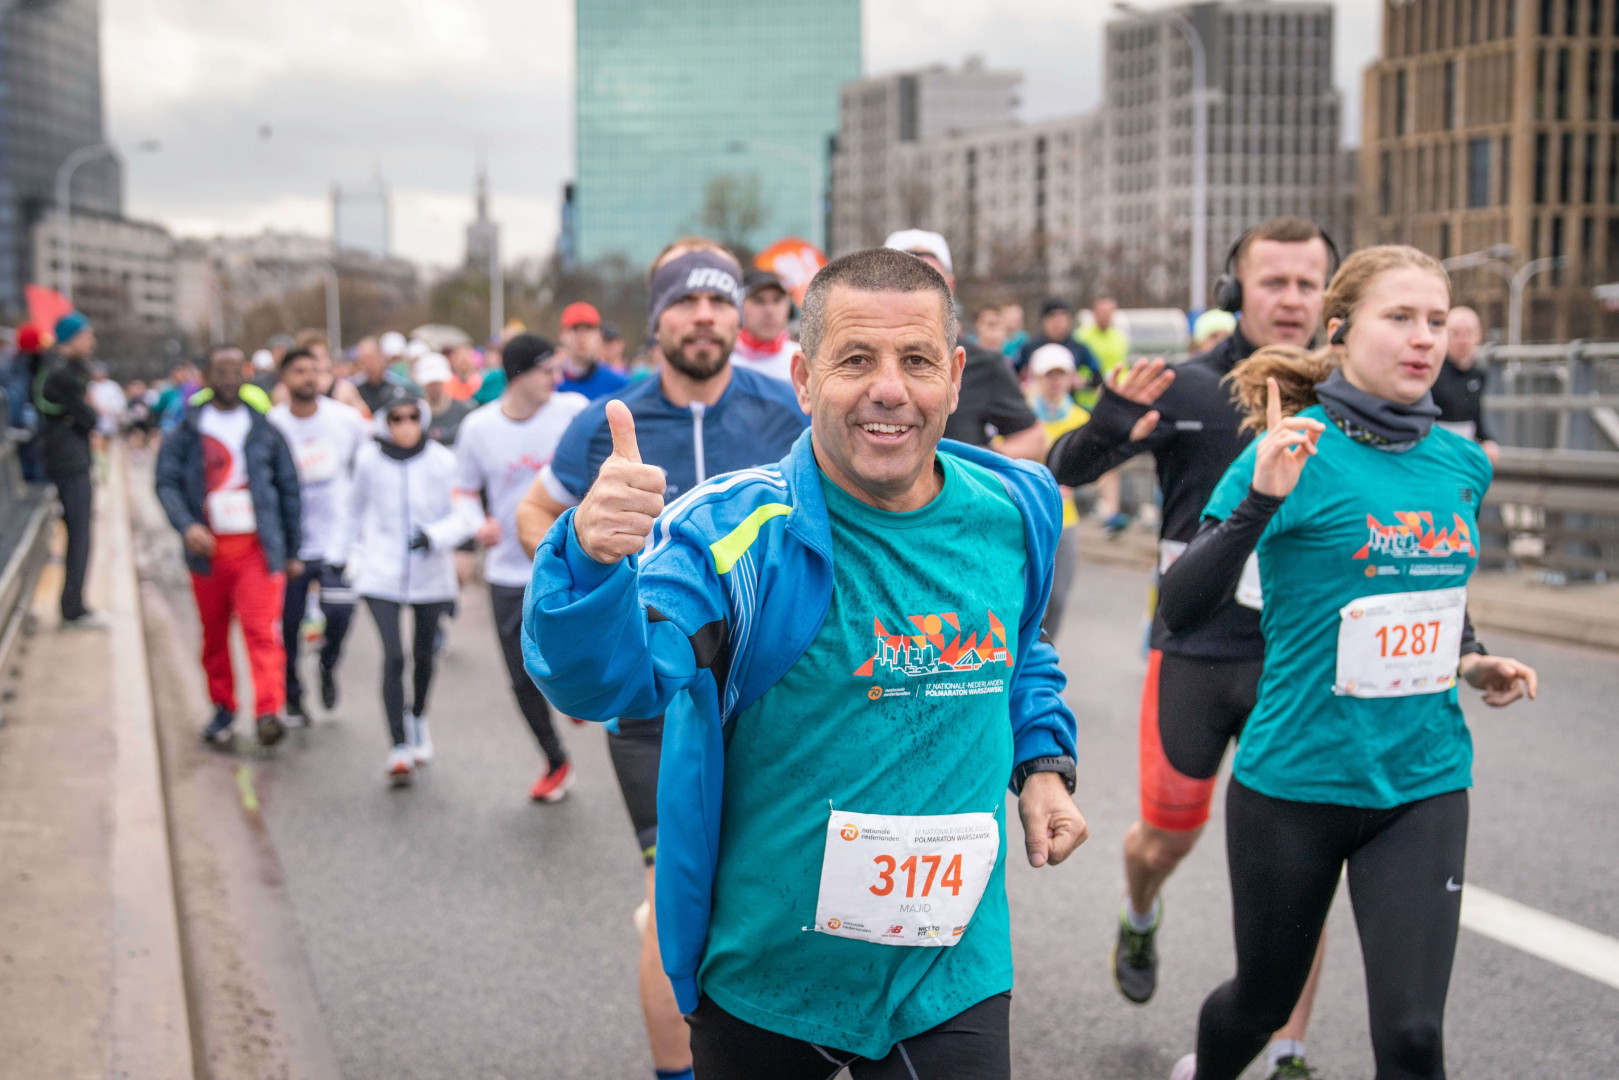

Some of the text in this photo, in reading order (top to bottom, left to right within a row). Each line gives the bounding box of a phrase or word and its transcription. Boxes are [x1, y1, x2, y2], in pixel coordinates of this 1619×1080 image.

[1375, 620, 1441, 658] 1287
[933, 679, 1004, 690] NATIONALE-NEDERLANDEN
[968, 686, 1004, 695] WARSZAWSKI
[861, 834, 900, 842] nederlanden
[957, 832, 991, 841] WARSZAWSK
[869, 853, 963, 898] 3174
[900, 904, 931, 913] MAJID
